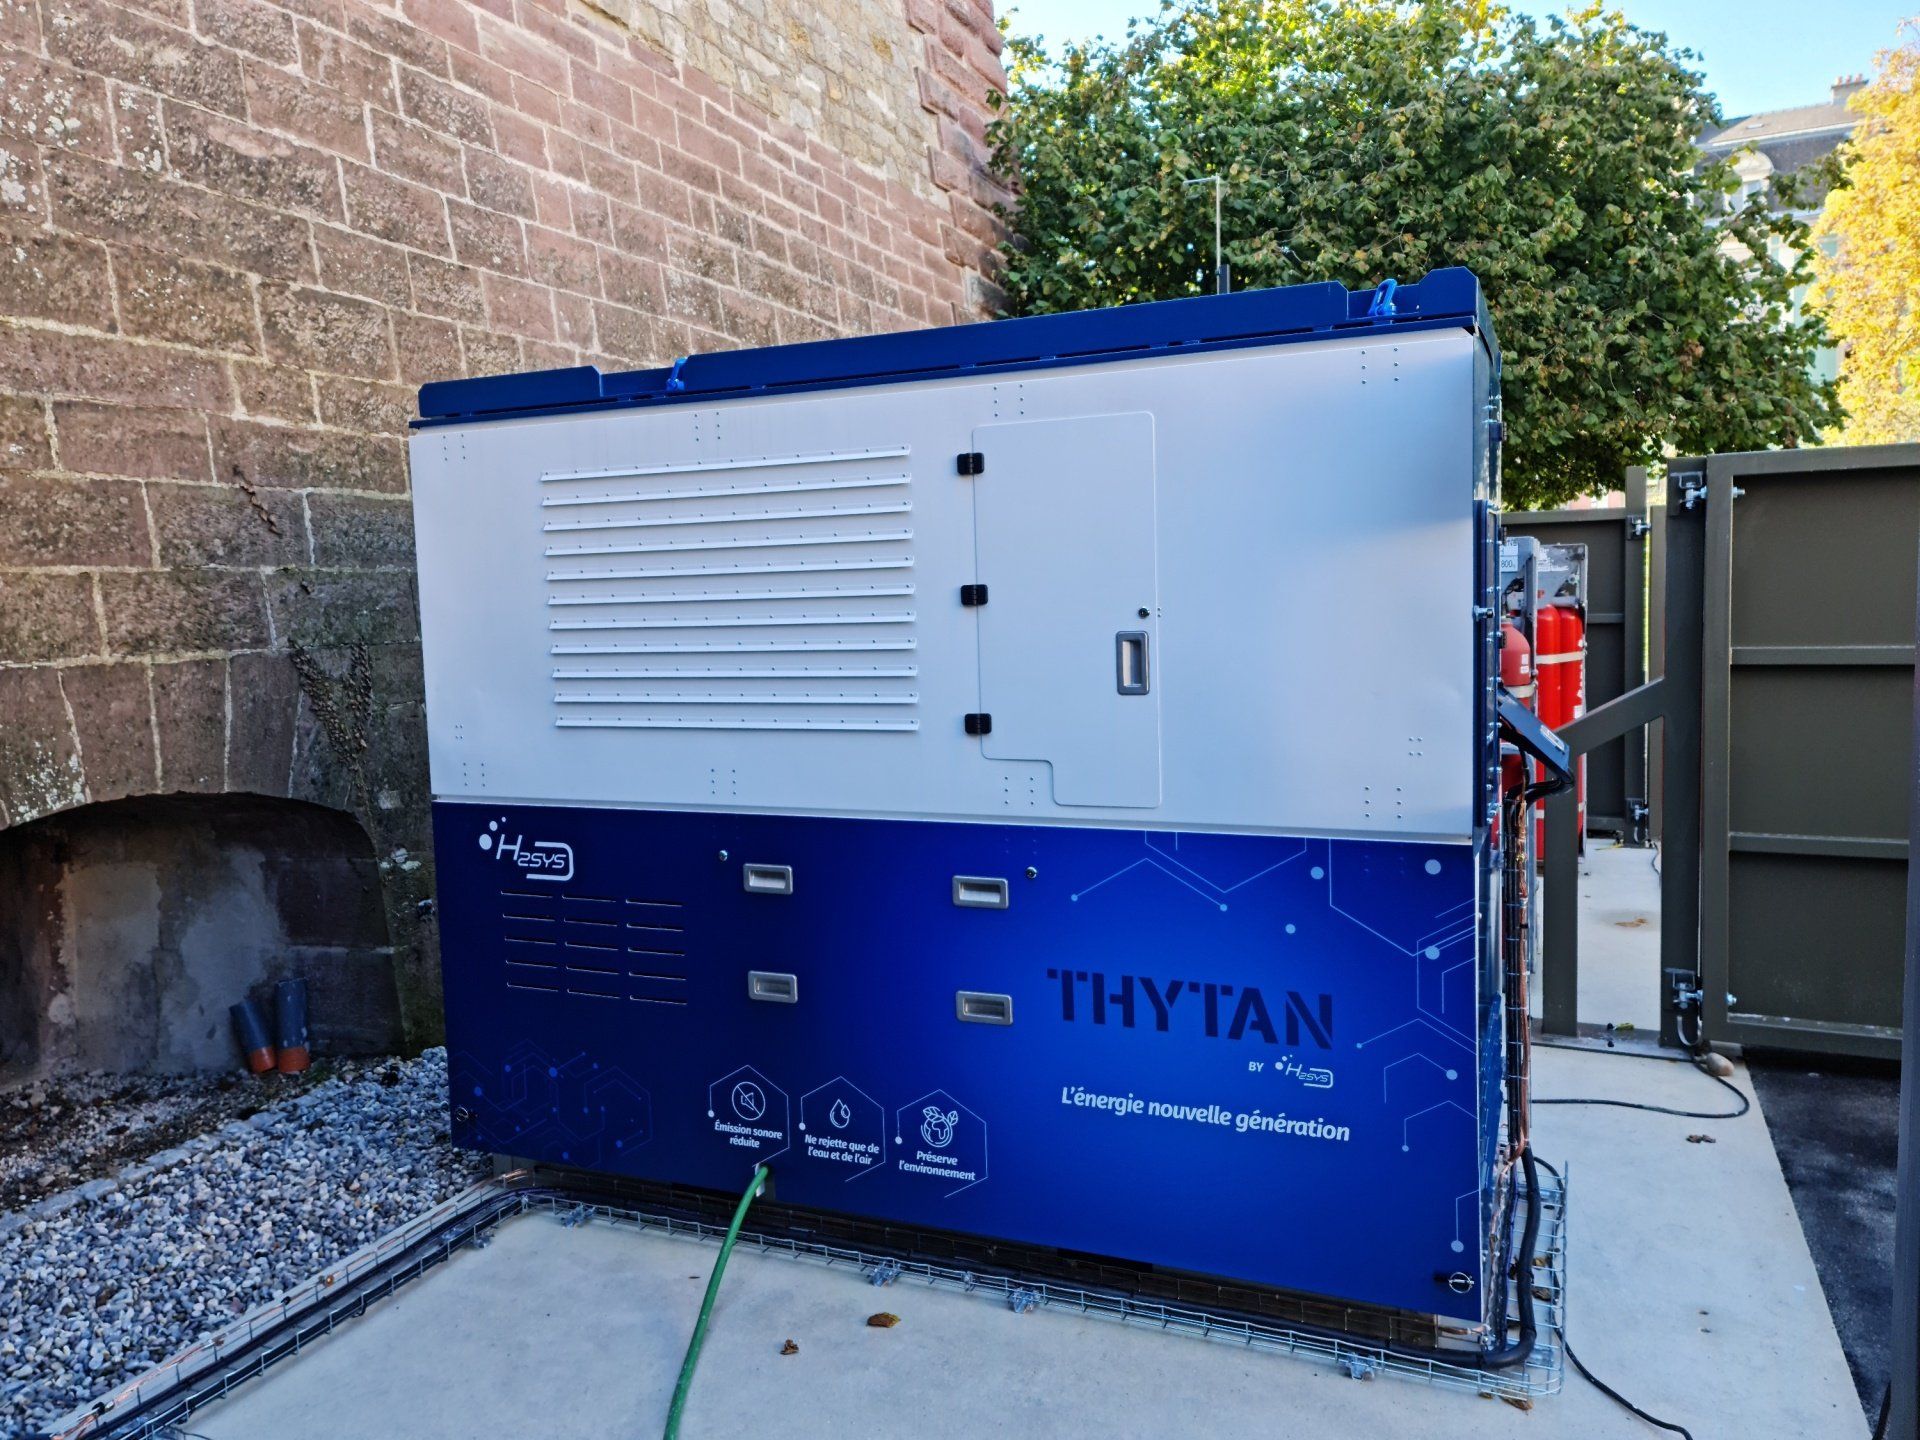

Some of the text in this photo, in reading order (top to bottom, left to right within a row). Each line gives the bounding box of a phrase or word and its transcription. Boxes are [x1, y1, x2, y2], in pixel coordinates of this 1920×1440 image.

[1047, 968, 1333, 1050] THYTAN
[1248, 1061, 1264, 1073] BY
[1061, 1086, 1350, 1142] L'énergie nouvelle génération
[714, 1119, 783, 1140] Émission sonore
[729, 1135, 760, 1148] réduite
[805, 1134, 880, 1154] Ne rejette que de
[808, 1146, 872, 1165] l'eau et de l'air
[916, 1150, 958, 1166] Préserve
[899, 1160, 976, 1181] l'environnement
